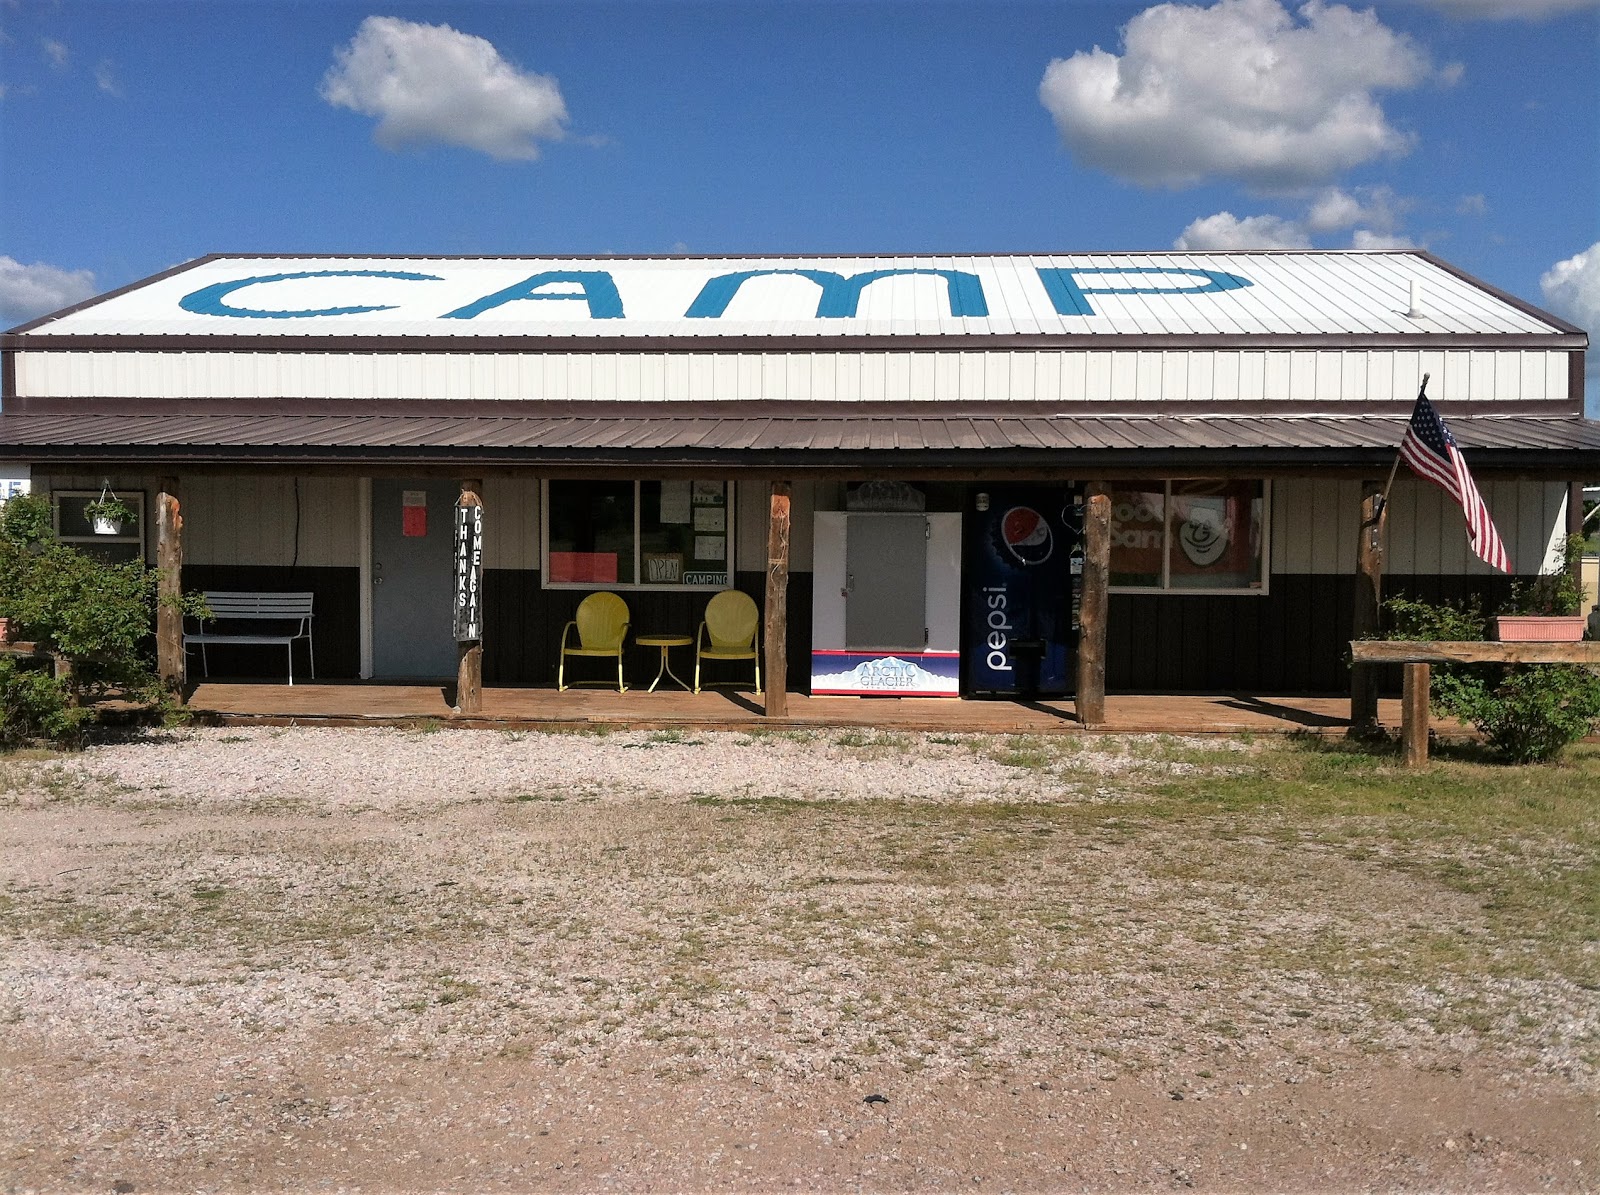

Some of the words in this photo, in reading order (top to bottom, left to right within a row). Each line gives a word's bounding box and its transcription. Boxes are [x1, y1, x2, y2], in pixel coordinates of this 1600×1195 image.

[459, 508, 469, 607] THANKS
[473, 506, 482, 566] COME
[650, 559, 678, 580] OPEN
[469, 566, 478, 638] AGAIN
[983, 586, 1013, 671] pepsi
[860, 663, 916, 678] ARCTIC
[860, 676, 916, 687] GLACIER
